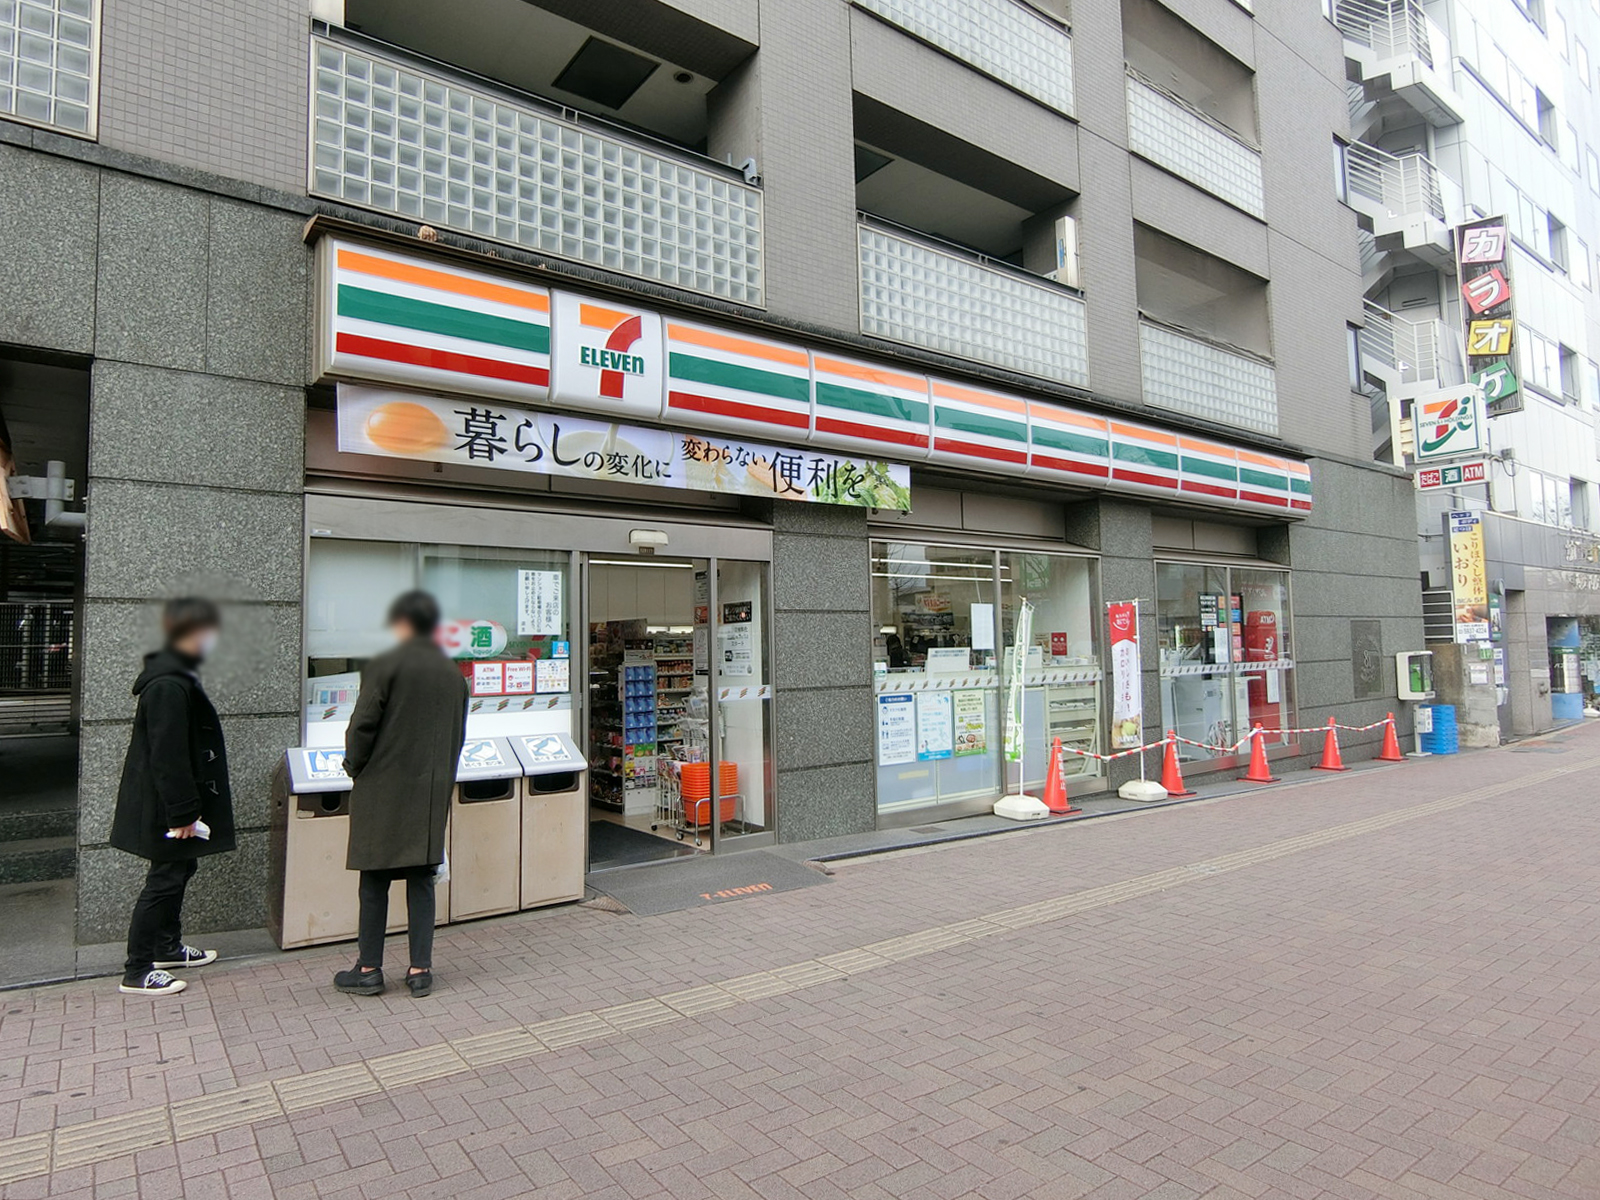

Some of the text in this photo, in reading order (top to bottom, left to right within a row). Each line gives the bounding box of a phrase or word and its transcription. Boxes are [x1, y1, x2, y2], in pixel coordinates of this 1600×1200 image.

[1466, 230, 1508, 398] カラオケ
[453, 406, 866, 499] 暮らしの変化に 変わらない便利を
[1420, 465, 1484, 486] たばこ 酒 ATM
[1453, 543, 1470, 588] いおり
[470, 625, 493, 648] 酒
